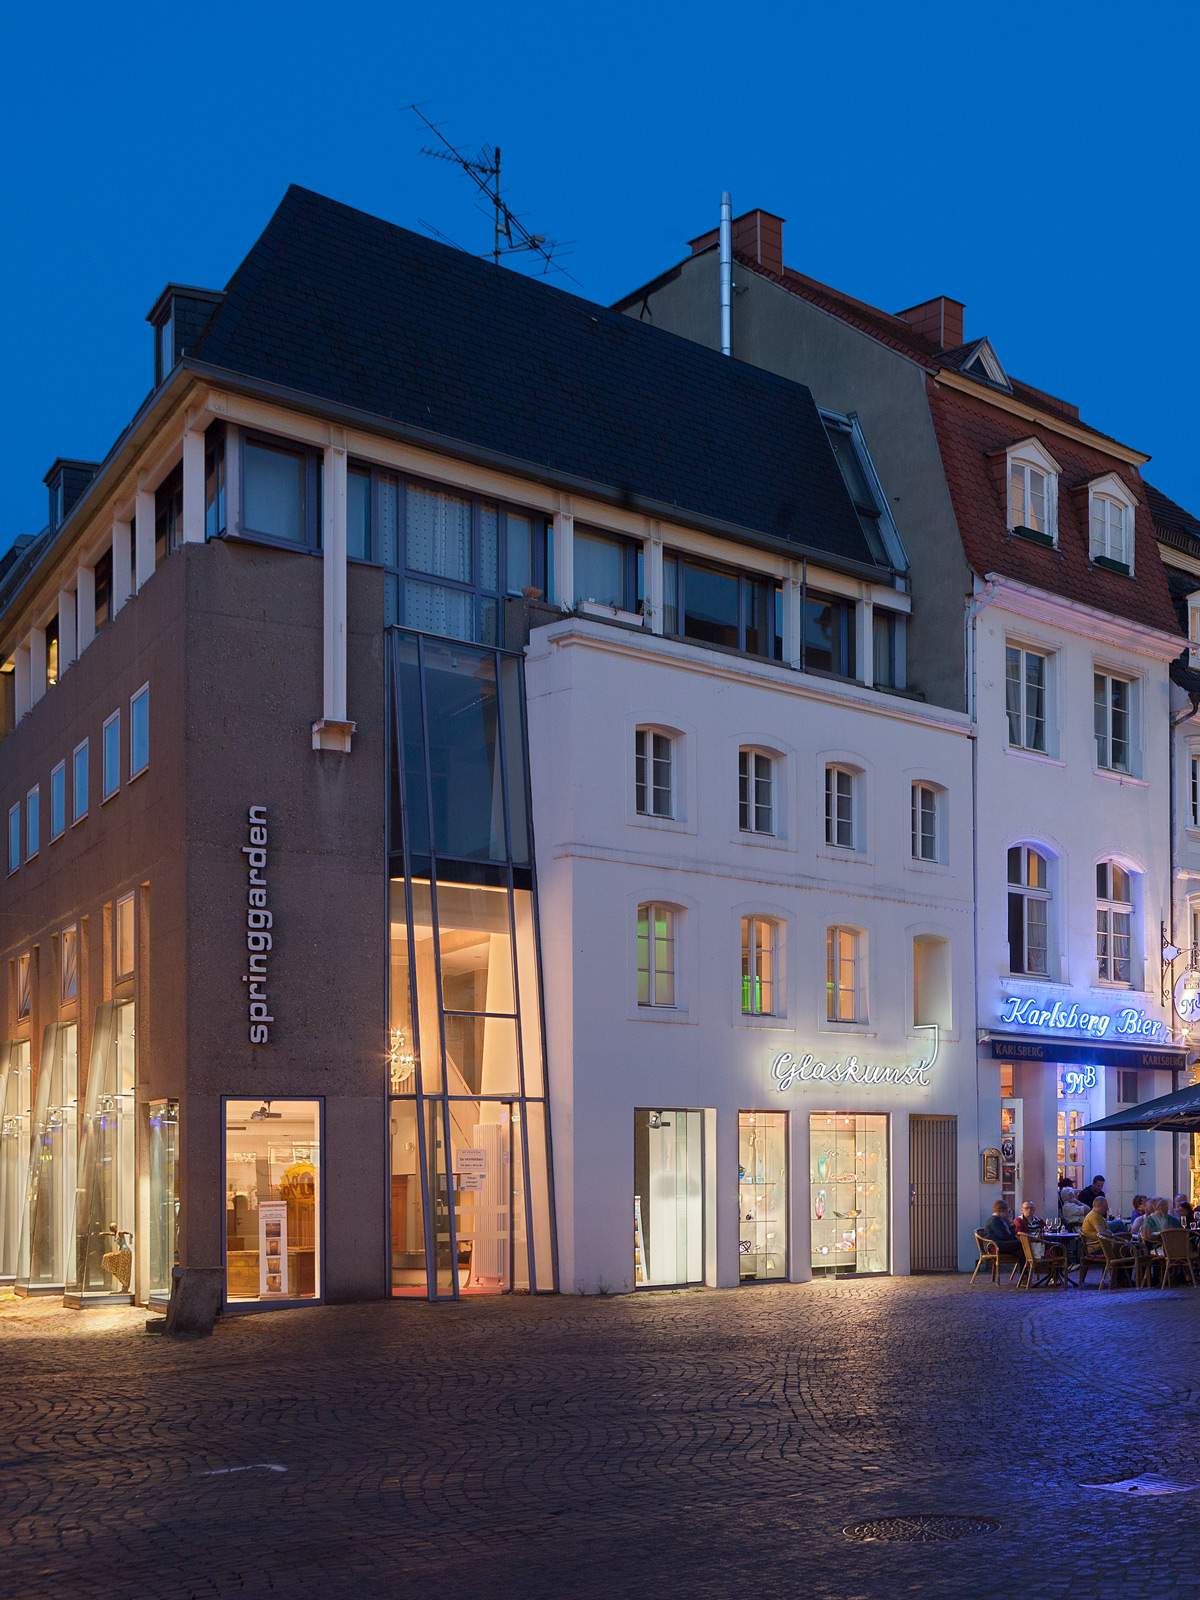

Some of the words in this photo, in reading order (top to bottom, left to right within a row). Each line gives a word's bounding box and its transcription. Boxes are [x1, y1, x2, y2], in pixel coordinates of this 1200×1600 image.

[242, 805, 274, 1044] springgarden
[1002, 997, 1111, 1037] Karlsberg
[1117, 1008, 1162, 1036] Bier
[771, 1042, 937, 1092] Glaskunst
[995, 1043, 1044, 1058] KARLSBERG
[1142, 1053, 1184, 1067] KARLSBERG
